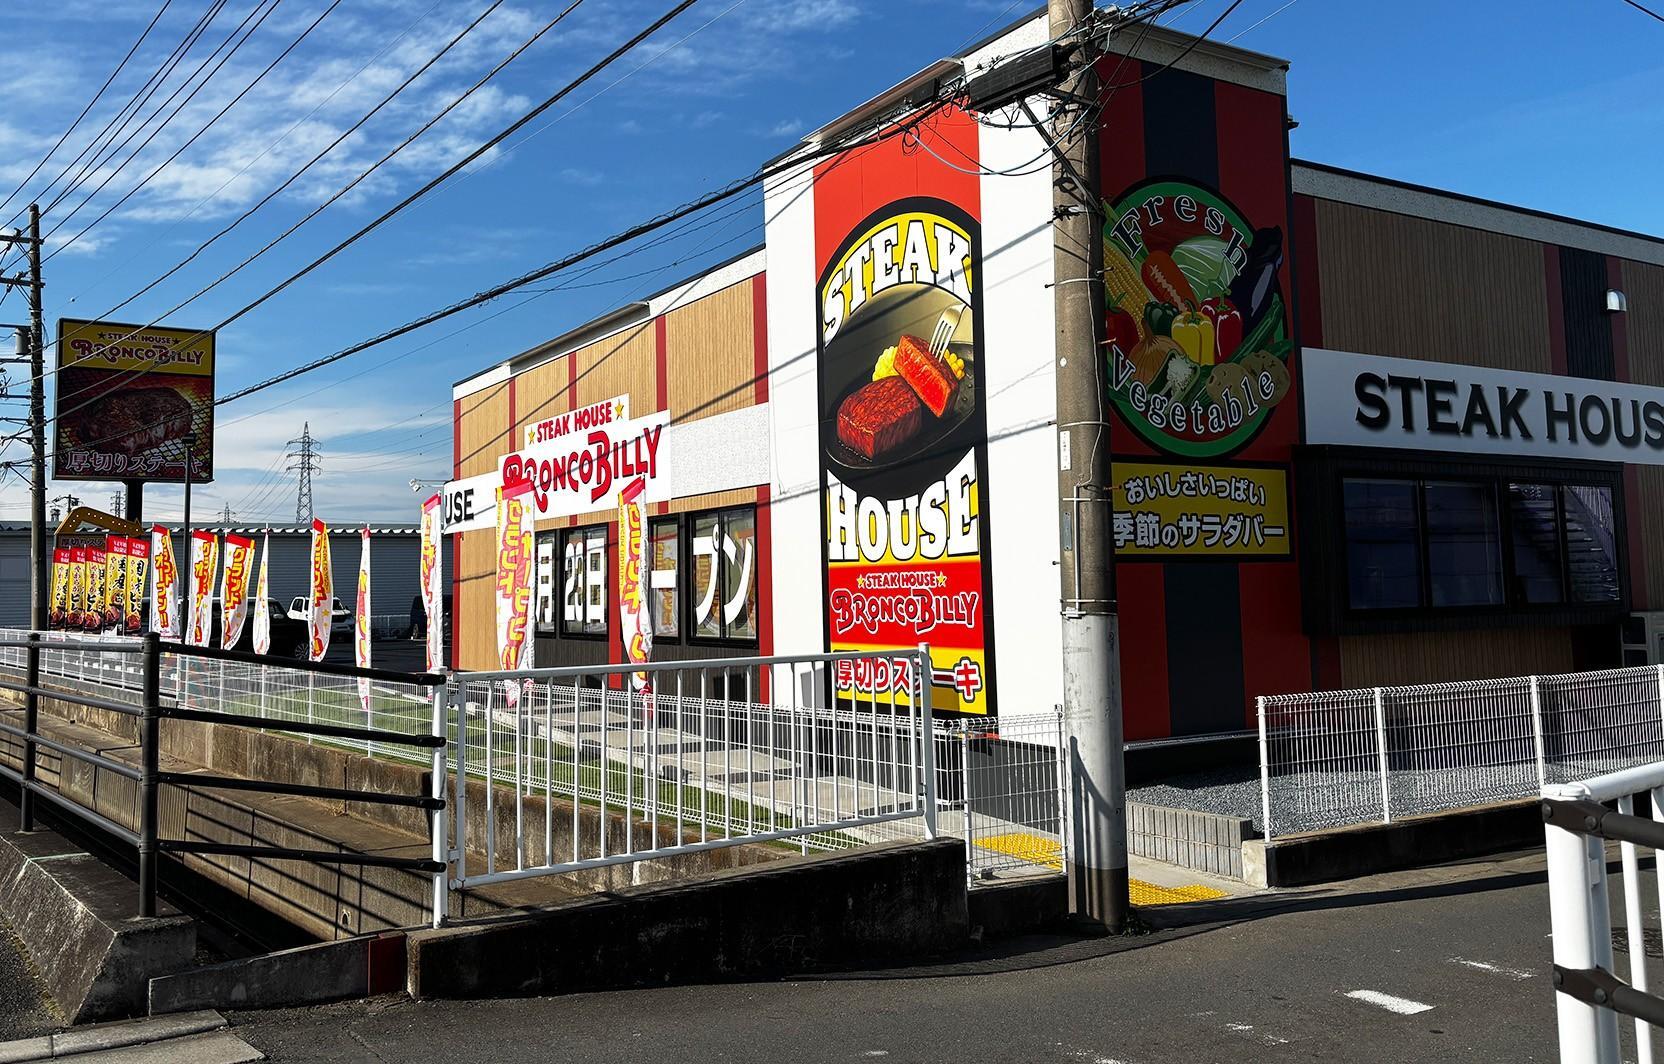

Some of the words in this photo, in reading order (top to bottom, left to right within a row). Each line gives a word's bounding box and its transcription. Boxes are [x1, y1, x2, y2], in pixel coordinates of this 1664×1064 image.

[1111, 193, 1249, 277] Fresh
[822, 219, 974, 348] STEAK
[107, 333, 138, 342] STEAK
[141, 335, 172, 344] HOUSE
[1110, 345, 1275, 435] Vegetable
[1354, 371, 1533, 440] STEAK
[1543, 390, 1664, 449] HOUS
[536, 416, 570, 443] STEAK
[574, 402, 613, 431] HOUSE
[444, 488, 475, 524] USE
[826, 445, 981, 565] HOUSE
[1125, 472, 1265, 506] おいしさいっぱい
[1112, 512, 1285, 550] 季節のサラダバー
[866, 573, 899, 588] STEAK
[901, 572, 936, 588] HOUSE
